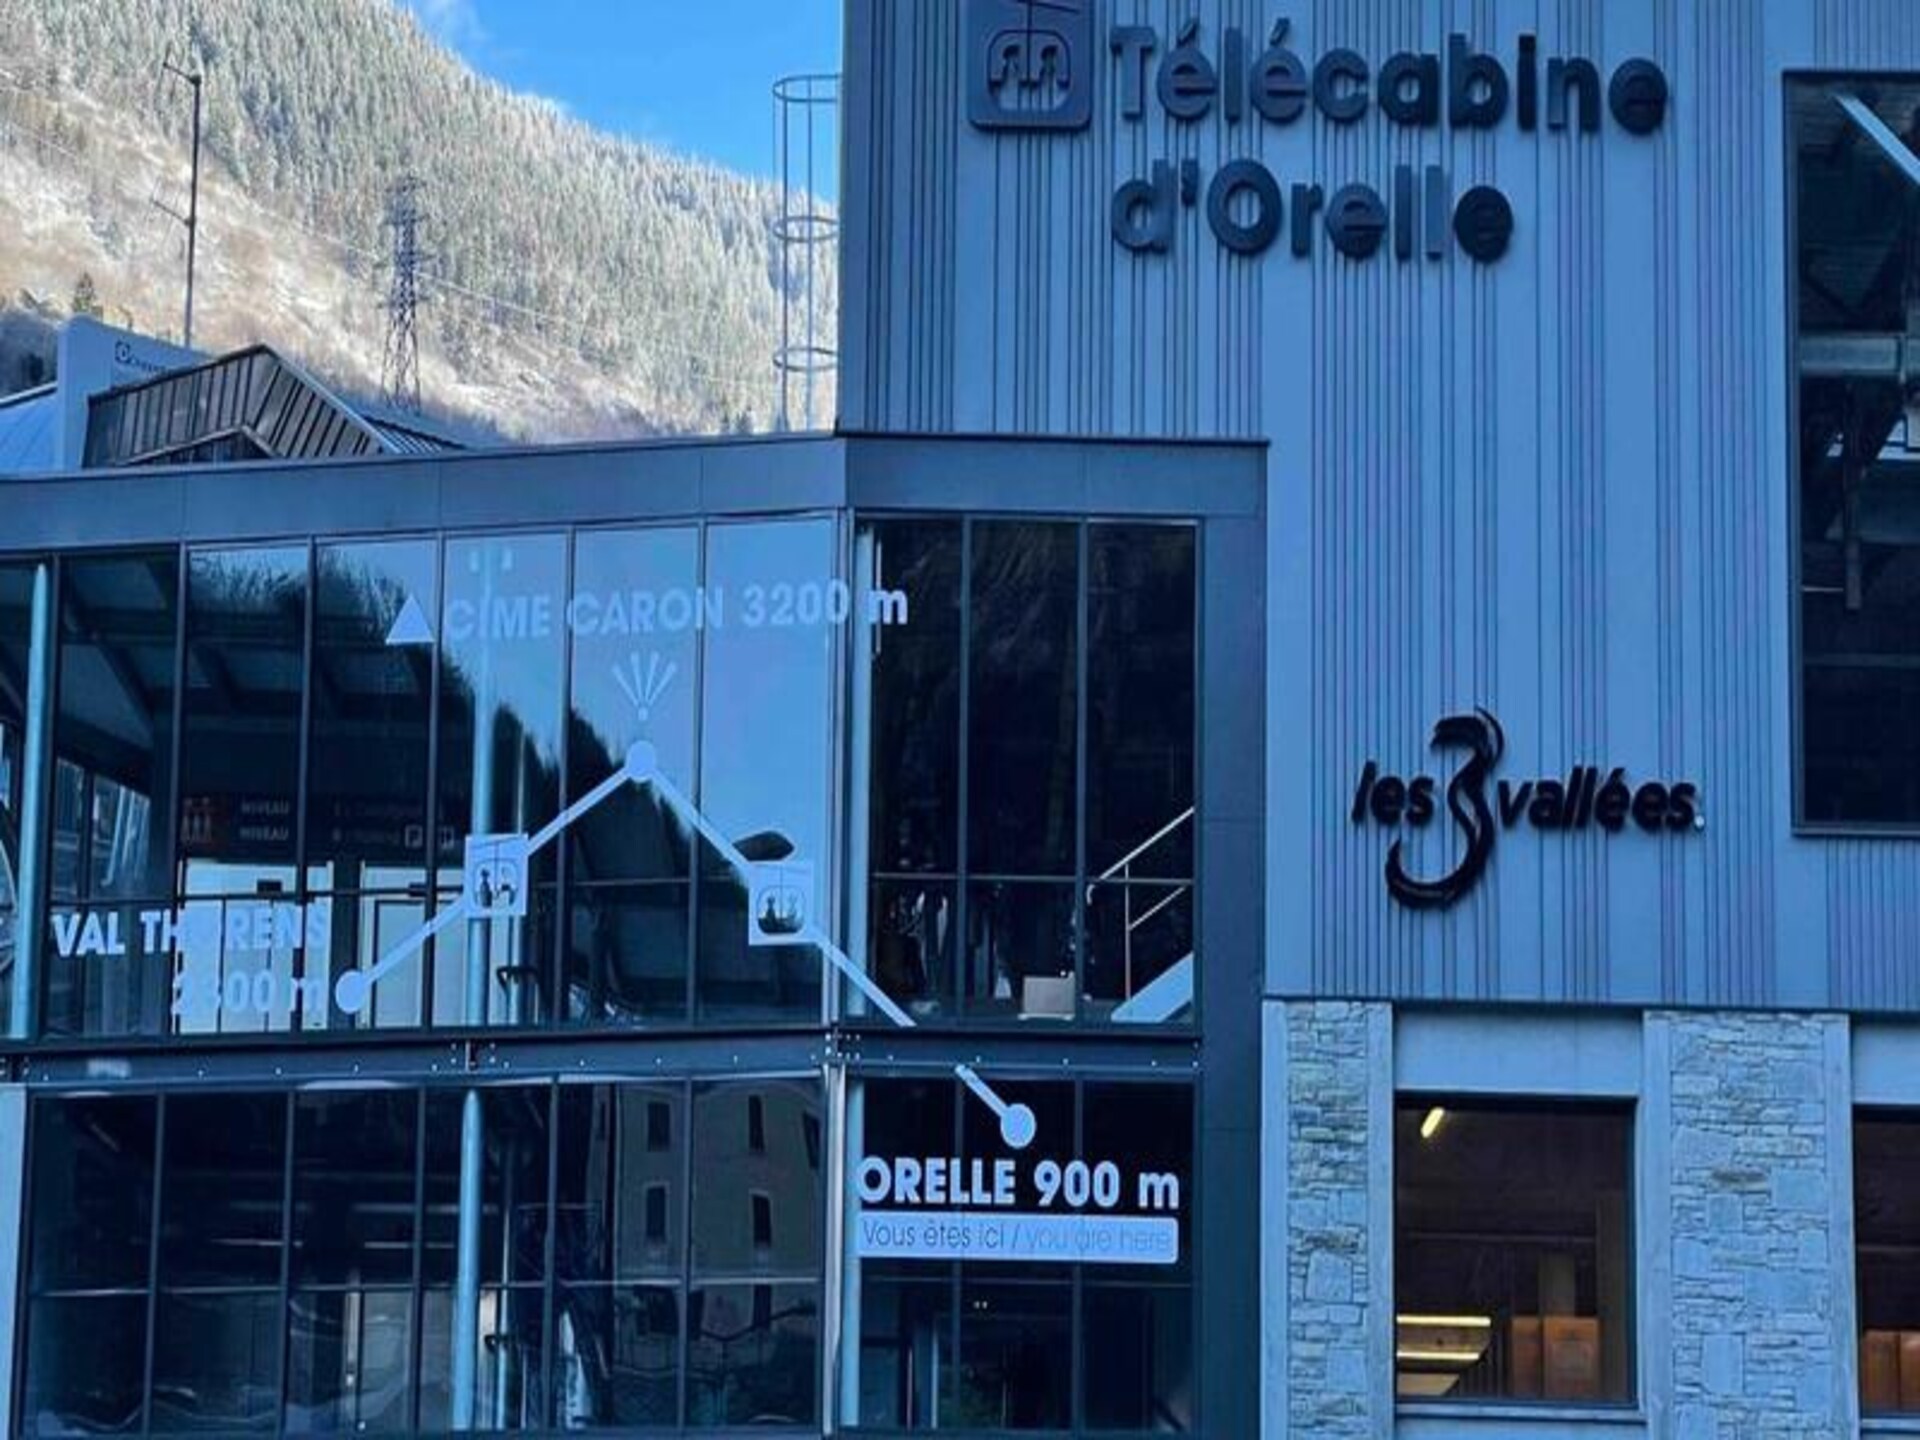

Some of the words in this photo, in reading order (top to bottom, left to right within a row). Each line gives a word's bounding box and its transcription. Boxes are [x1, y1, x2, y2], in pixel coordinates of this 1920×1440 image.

[1110, 18, 1669, 136] Télécabine
[1110, 157, 1514, 263] d'Orelle
[444, 594, 552, 642] CIME
[567, 585, 726, 636] CARON
[741, 578, 850, 627] 3200
[867, 587, 909, 626] m
[1351, 760, 1436, 827] les
[1384, 705, 1505, 910] 3
[51, 912, 126, 957] VAL
[140, 907, 325, 954] THRENS
[856, 1155, 1017, 1206] ORELLE
[1033, 1159, 1121, 1208] 900
[1137, 1171, 1180, 1210] m
[862, 1219, 917, 1247] Vous
[923, 1218, 971, 1250] êtes
[976, 1222, 1005, 1249] ici
